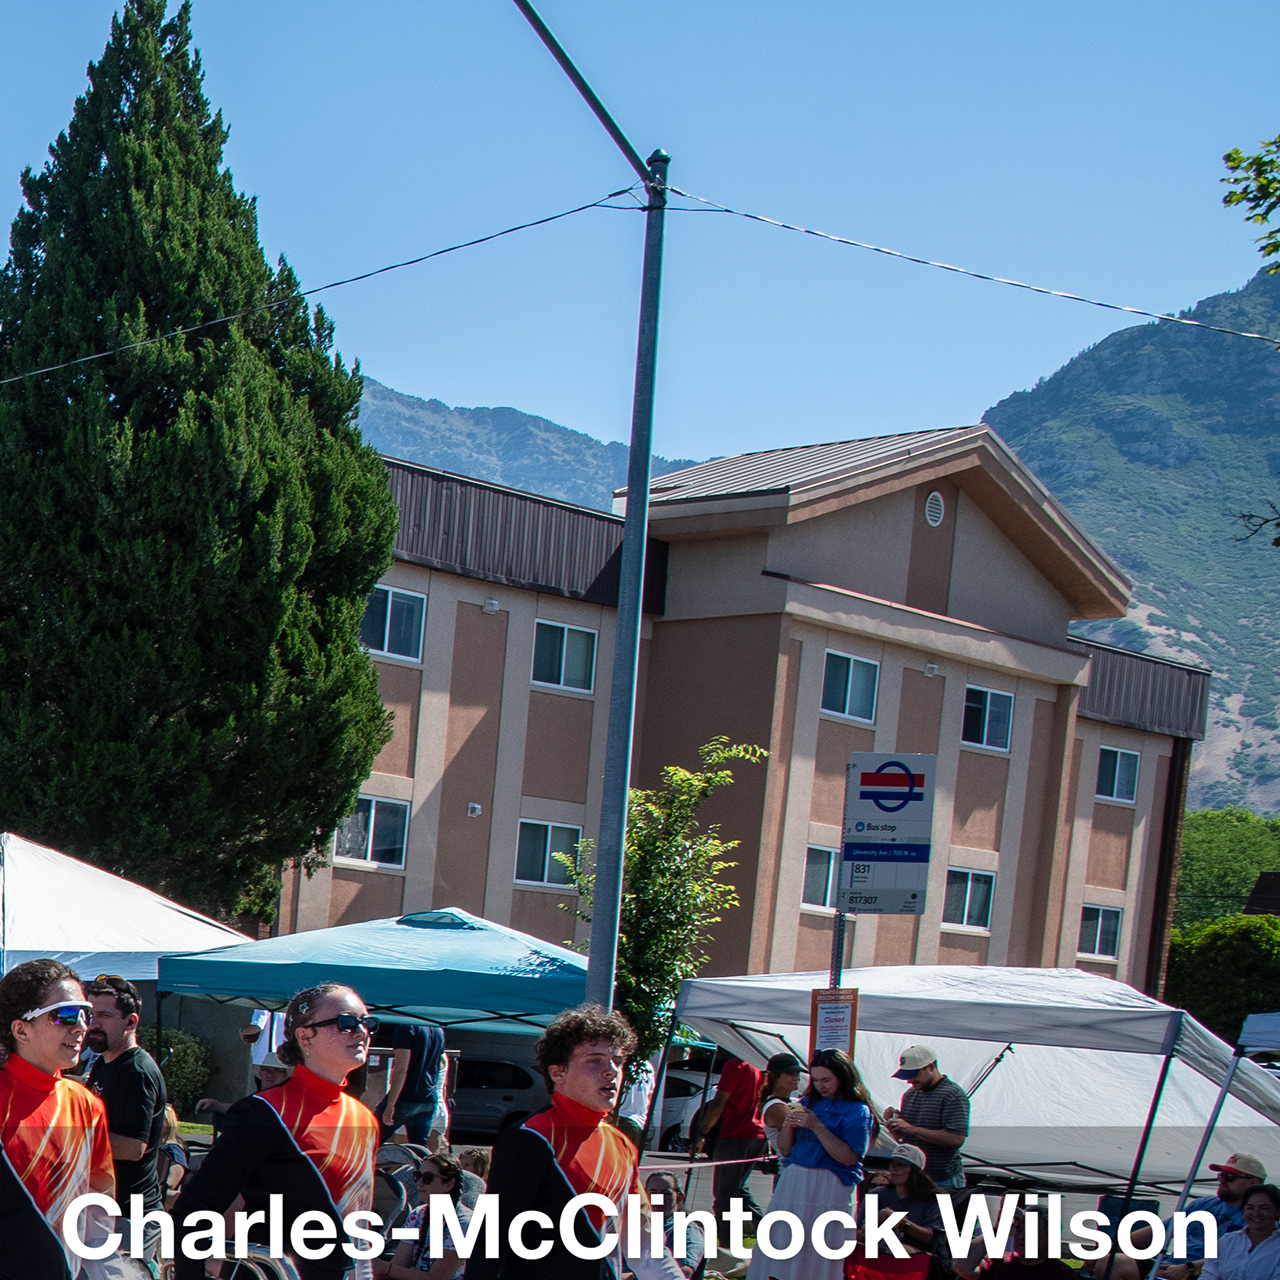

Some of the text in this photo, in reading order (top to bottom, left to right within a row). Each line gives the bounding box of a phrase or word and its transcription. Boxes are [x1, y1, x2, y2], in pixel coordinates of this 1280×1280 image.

[866, 823, 897, 833] Bus stop
[854, 864, 871, 874] 831
[848, 896, 878, 905] 817307
